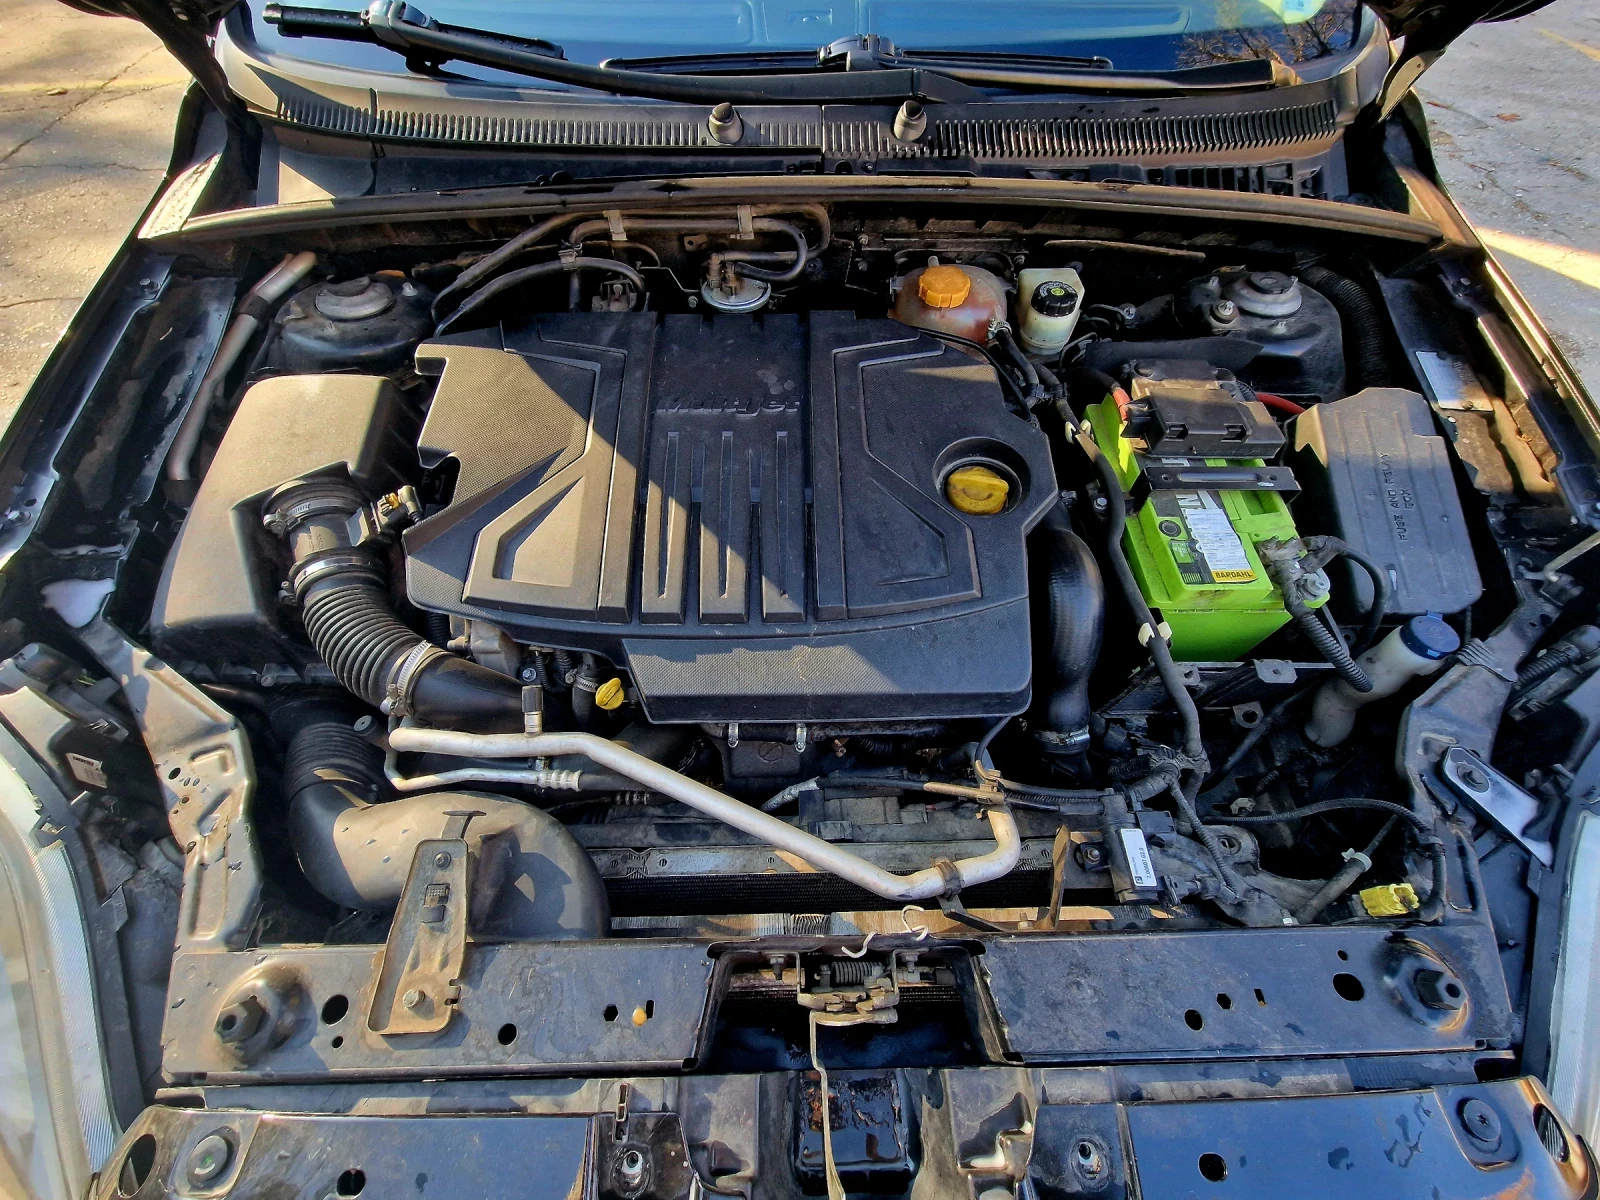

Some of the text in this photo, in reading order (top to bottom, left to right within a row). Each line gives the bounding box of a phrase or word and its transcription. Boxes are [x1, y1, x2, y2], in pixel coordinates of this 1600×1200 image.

[1380, 452, 1408, 541] FUSE AND RELAY
[1400, 489, 1415, 510] BOX
[1214, 569, 1254, 580] BARDAHL
